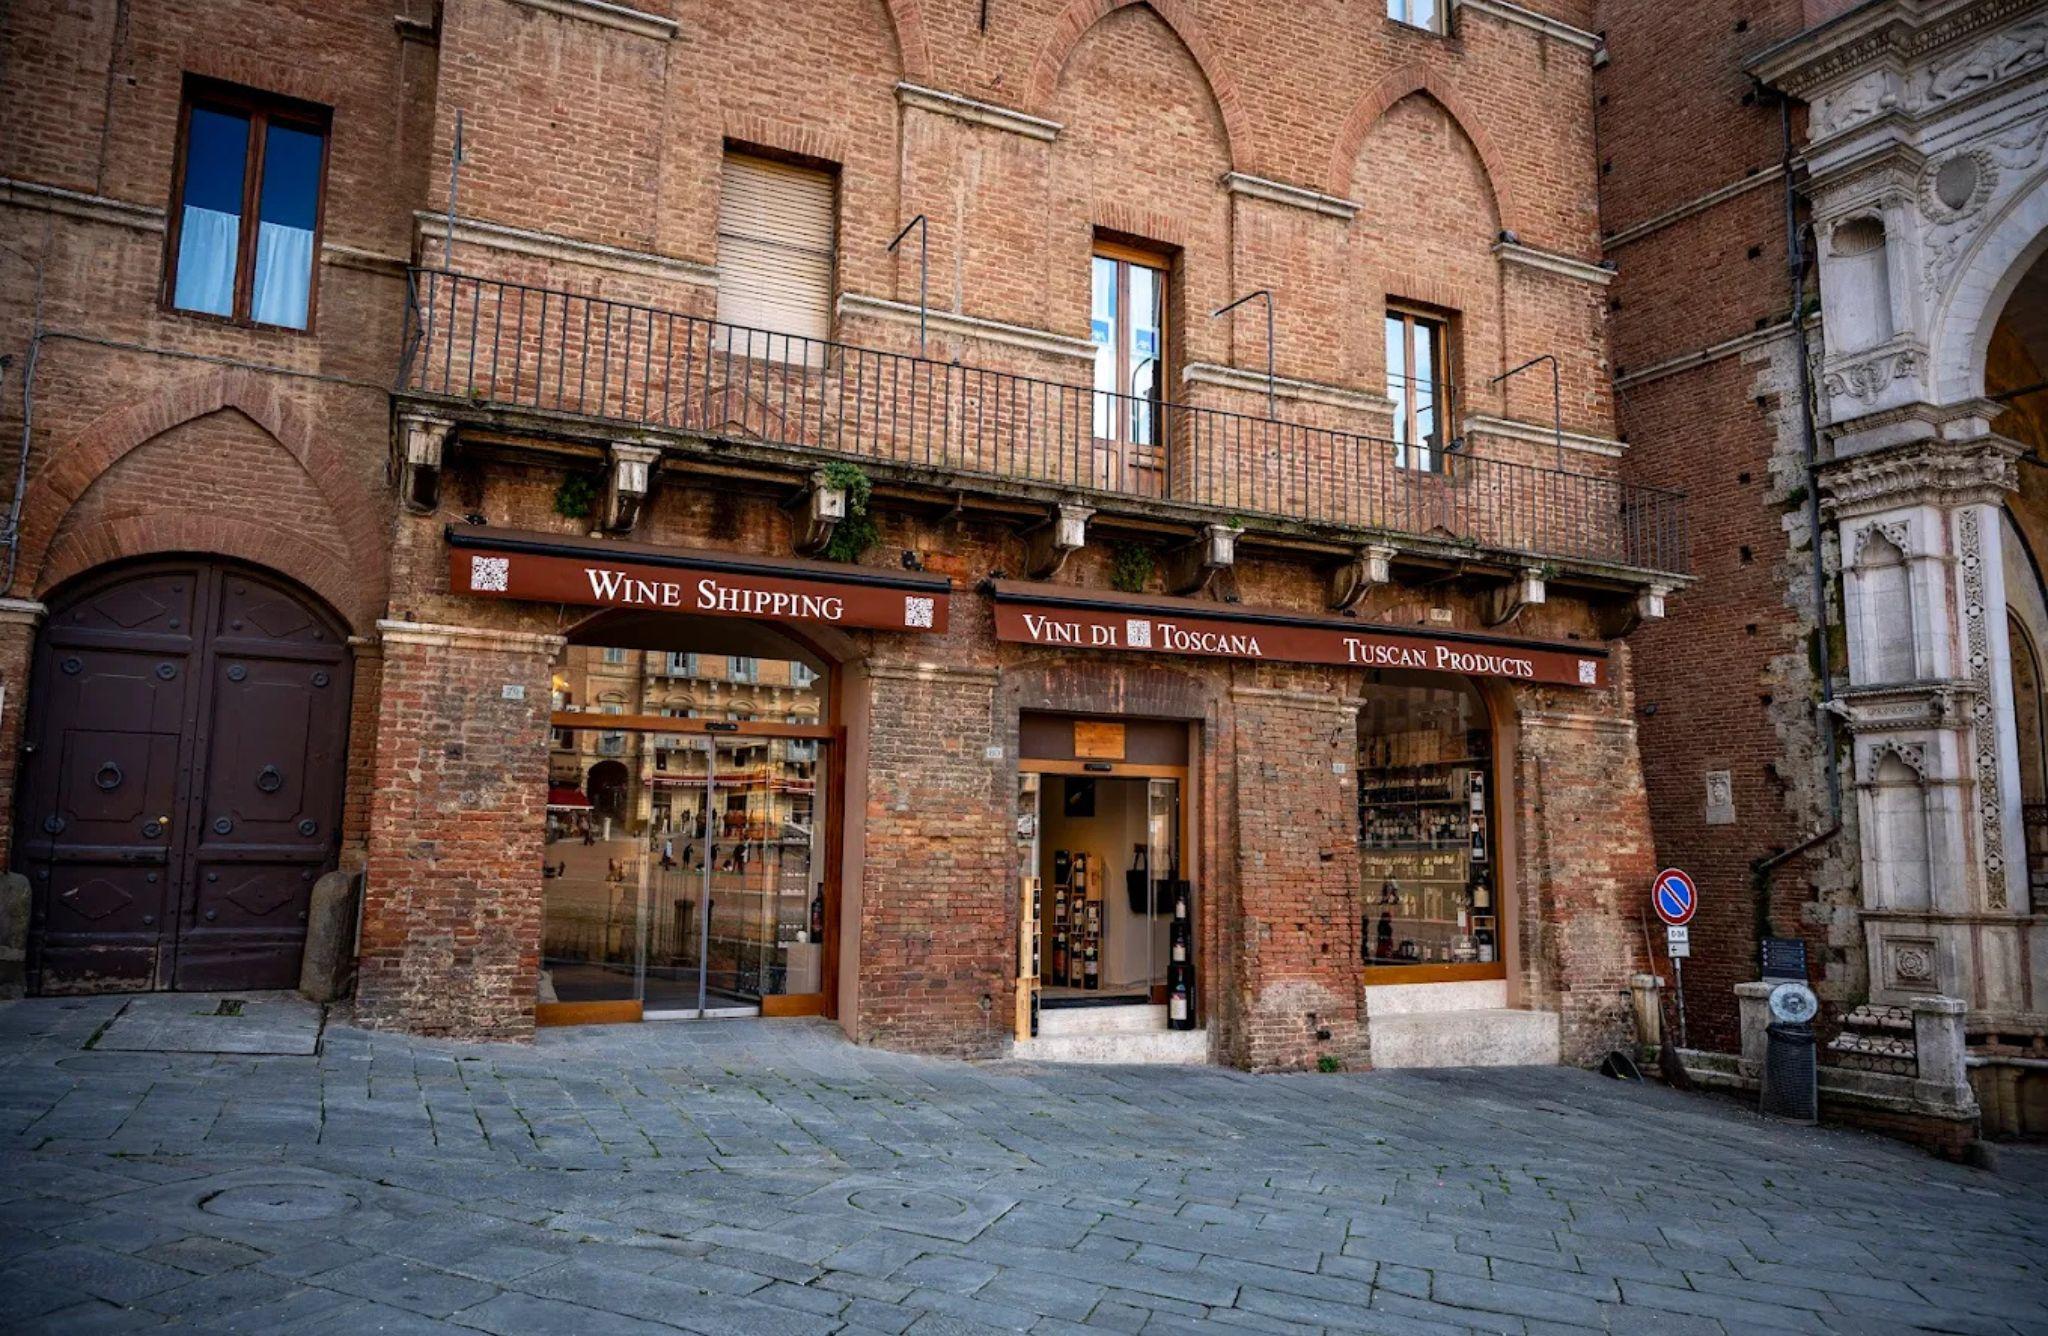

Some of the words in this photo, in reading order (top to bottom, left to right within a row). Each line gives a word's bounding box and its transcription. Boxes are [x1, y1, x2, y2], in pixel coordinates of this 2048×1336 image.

[585, 568, 681, 607] WINE
[697, 578, 844, 621] SHIPPING
[1022, 614, 1082, 645] VINI
[1091, 624, 1117, 647] DI
[1157, 623, 1262, 656] TOSCANA
[1343, 638, 1427, 668] TUSCAN
[1436, 645, 1534, 678] PRODUCTS
